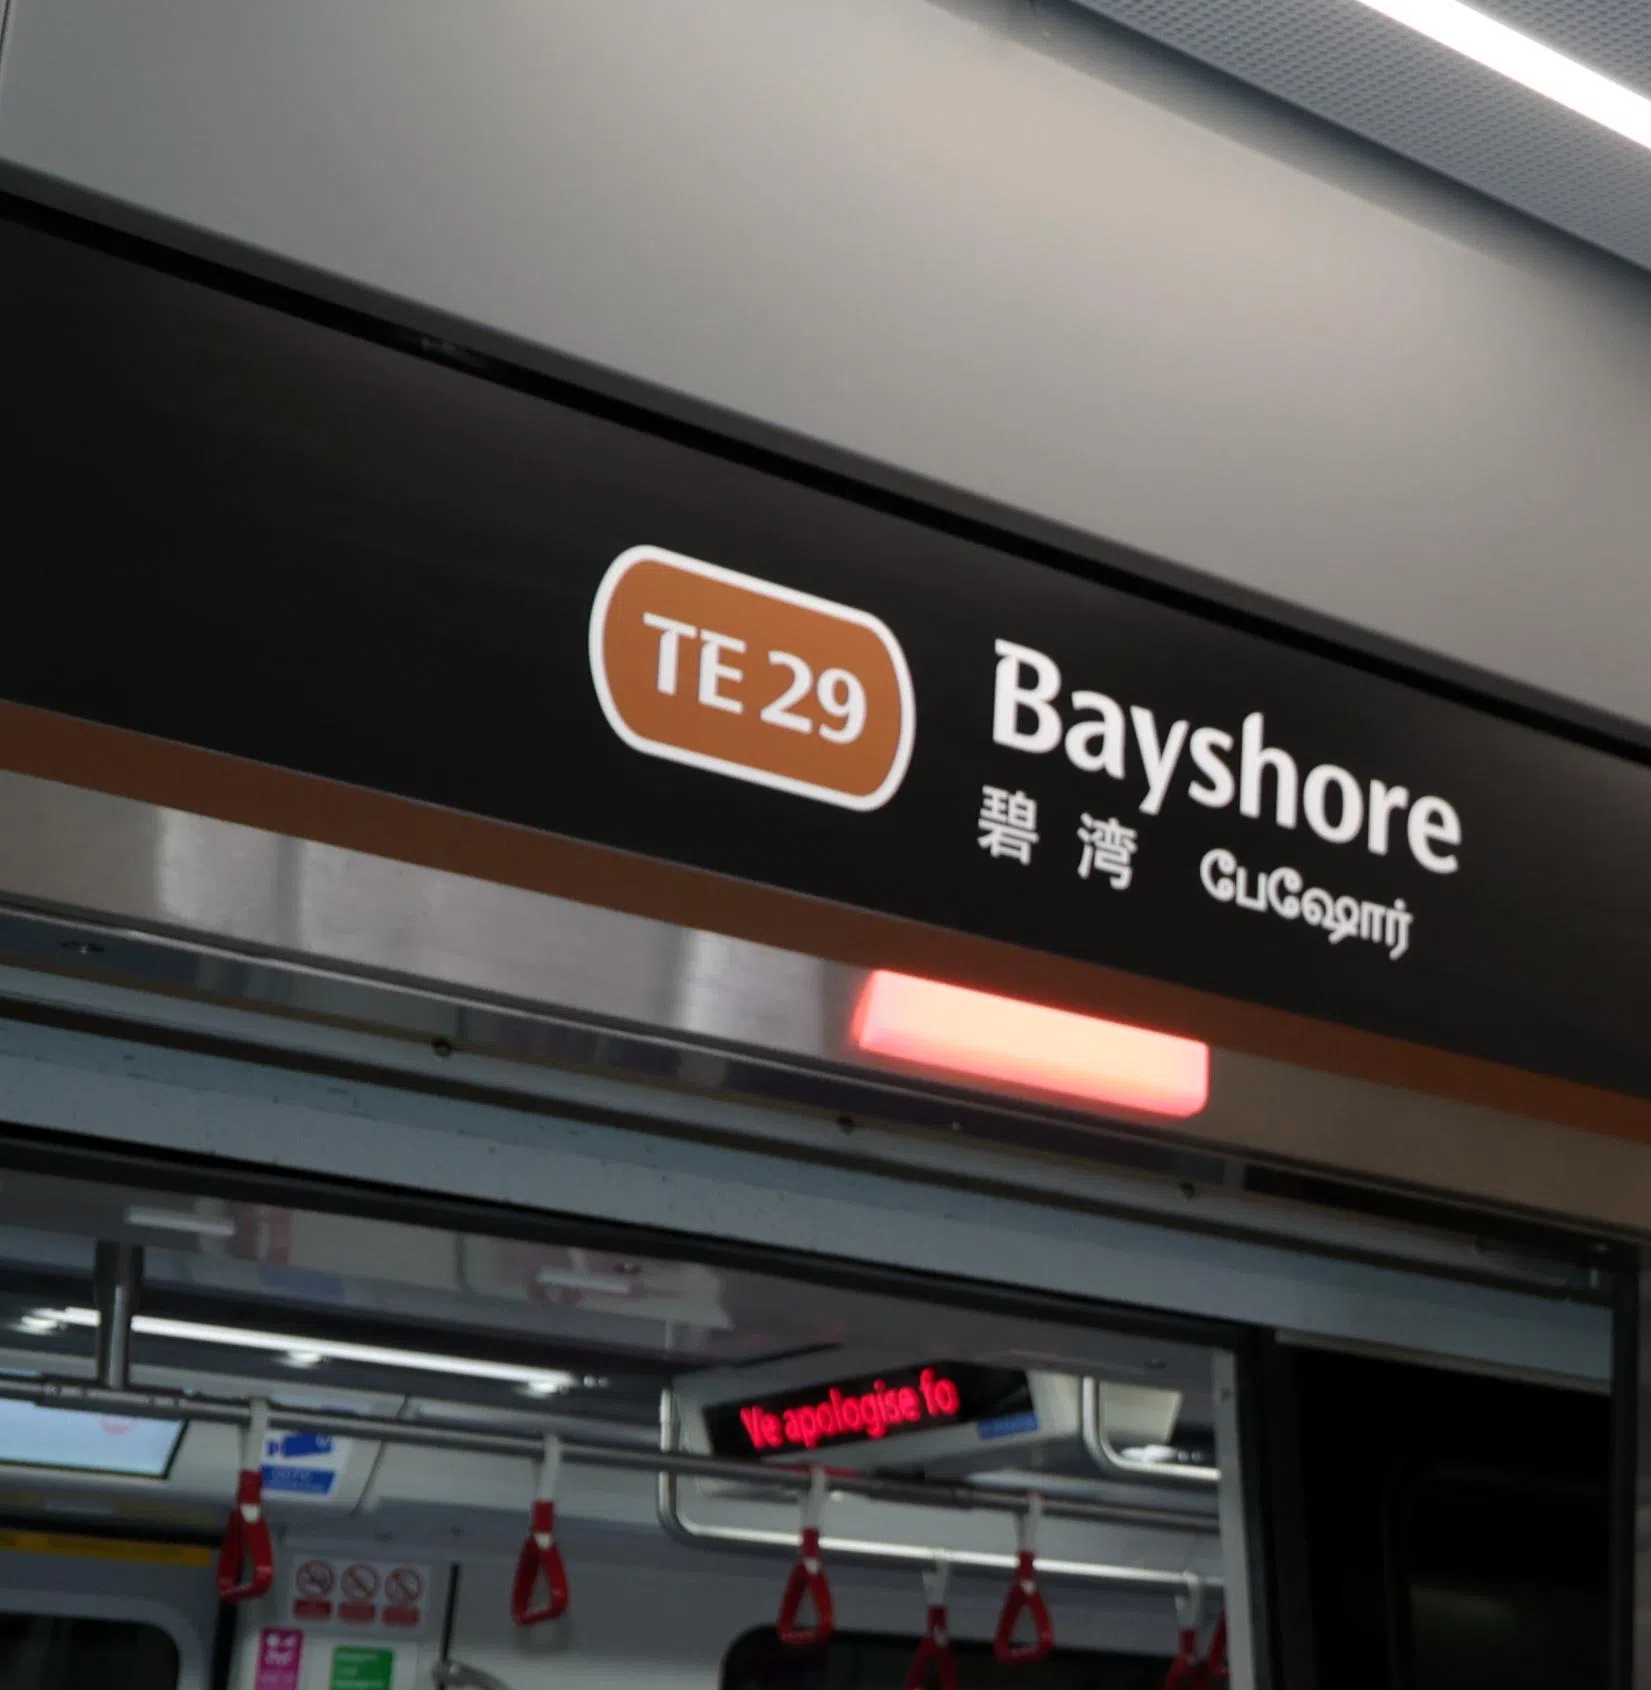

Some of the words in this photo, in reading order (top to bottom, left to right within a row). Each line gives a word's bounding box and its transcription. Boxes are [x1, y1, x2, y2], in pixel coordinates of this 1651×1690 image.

[642, 612, 746, 715] TE
[759, 649, 868, 745] 29
[991, 638, 1461, 874] Bayshore
[782, 1378, 921, 1449] apologise
